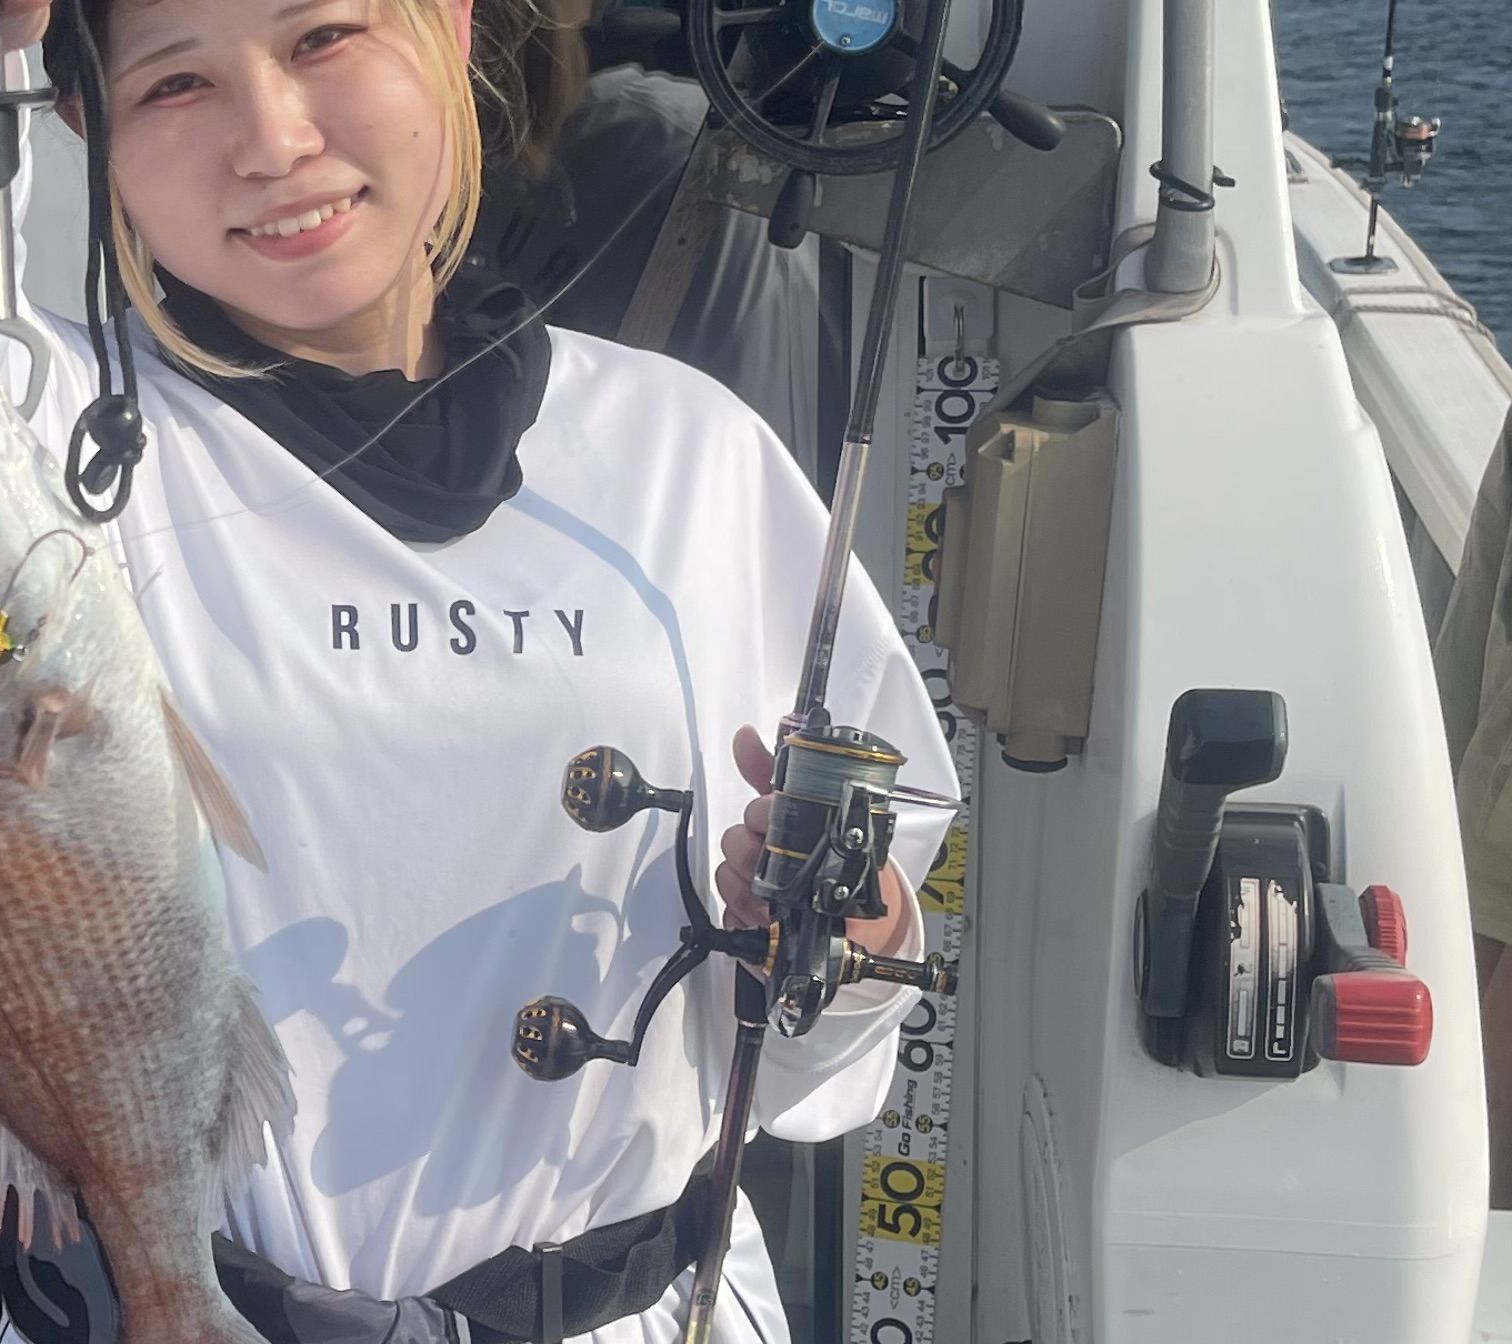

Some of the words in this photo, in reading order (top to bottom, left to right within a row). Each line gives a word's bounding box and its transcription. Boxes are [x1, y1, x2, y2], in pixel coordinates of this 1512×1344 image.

[934, 356, 978, 445] 100
[330, 598, 585, 657] RUSTY
[902, 1079, 918, 1130] Fishing
[885, 1110, 899, 1128] 55
[916, 1115, 932, 1134] 55
[898, 1132, 911, 1156] Go
[877, 1161, 925, 1238] 50
[874, 1272, 887, 1290] 45
[905, 1278, 918, 1296] 45
